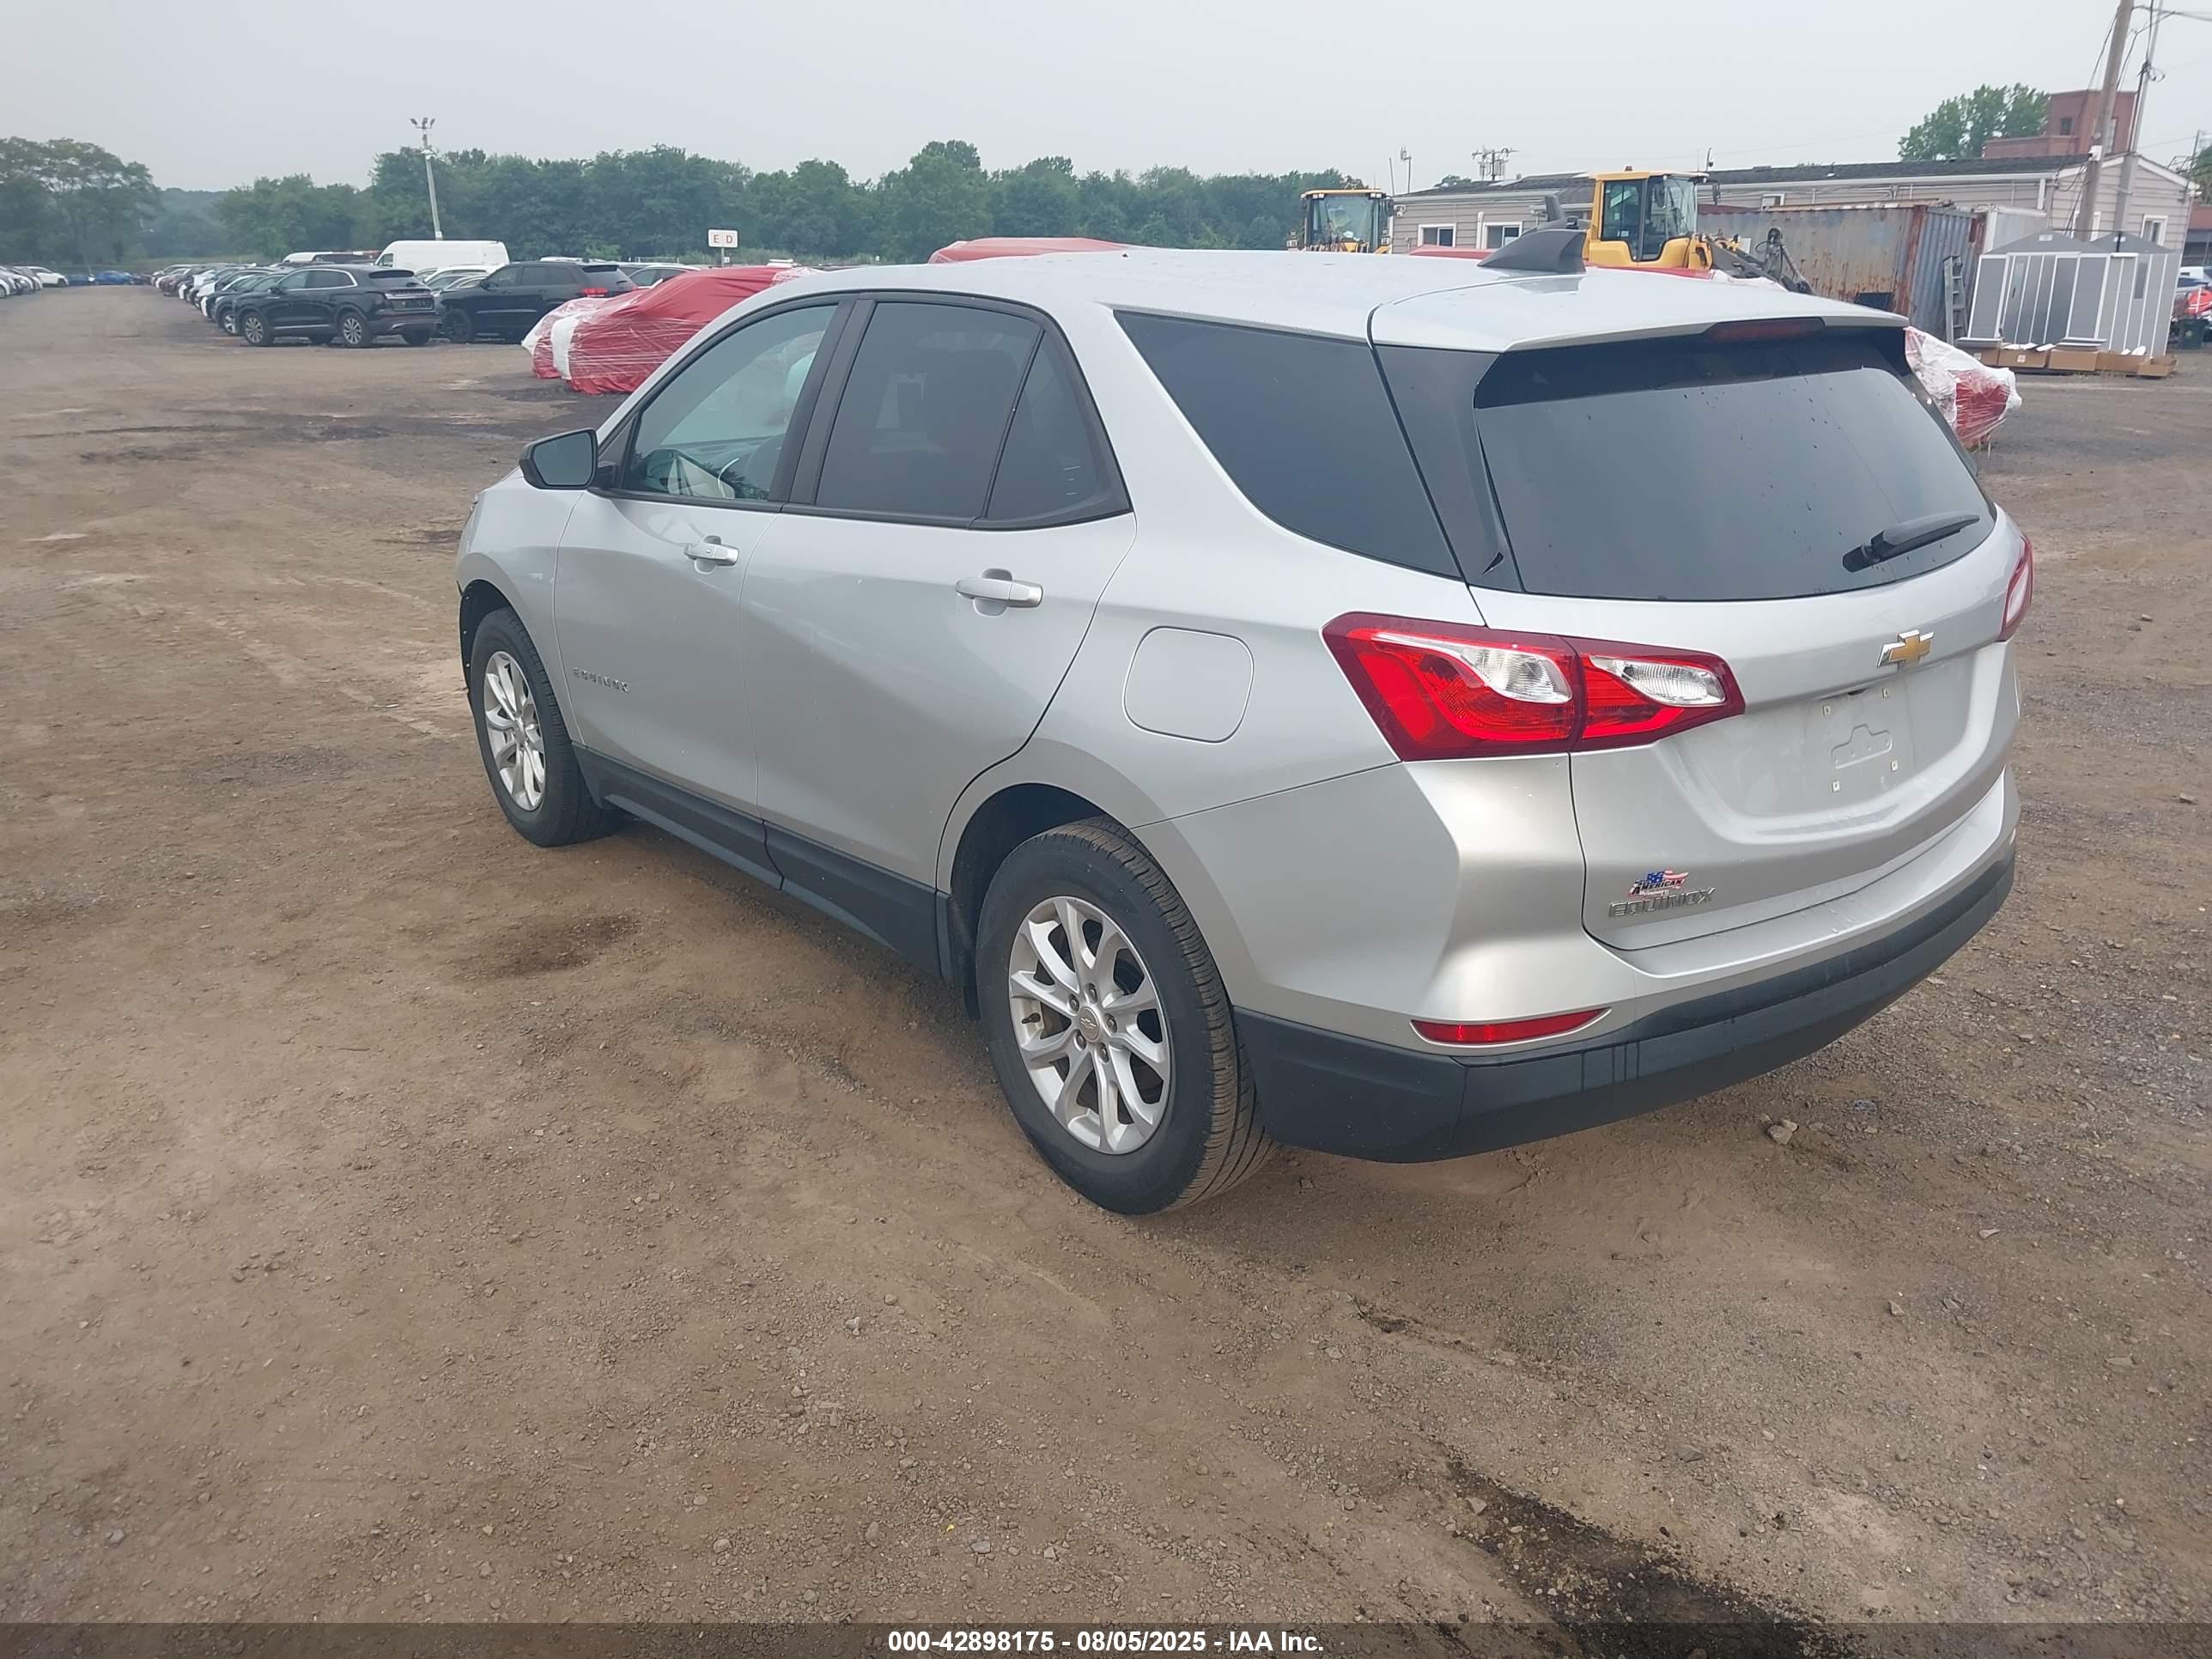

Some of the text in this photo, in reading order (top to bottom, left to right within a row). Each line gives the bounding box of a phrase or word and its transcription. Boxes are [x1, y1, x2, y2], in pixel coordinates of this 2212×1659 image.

[714, 234, 733, 244] E D
[1632, 878, 1683, 895] AMERICAN
[1608, 887, 1717, 918] EQUINOX
